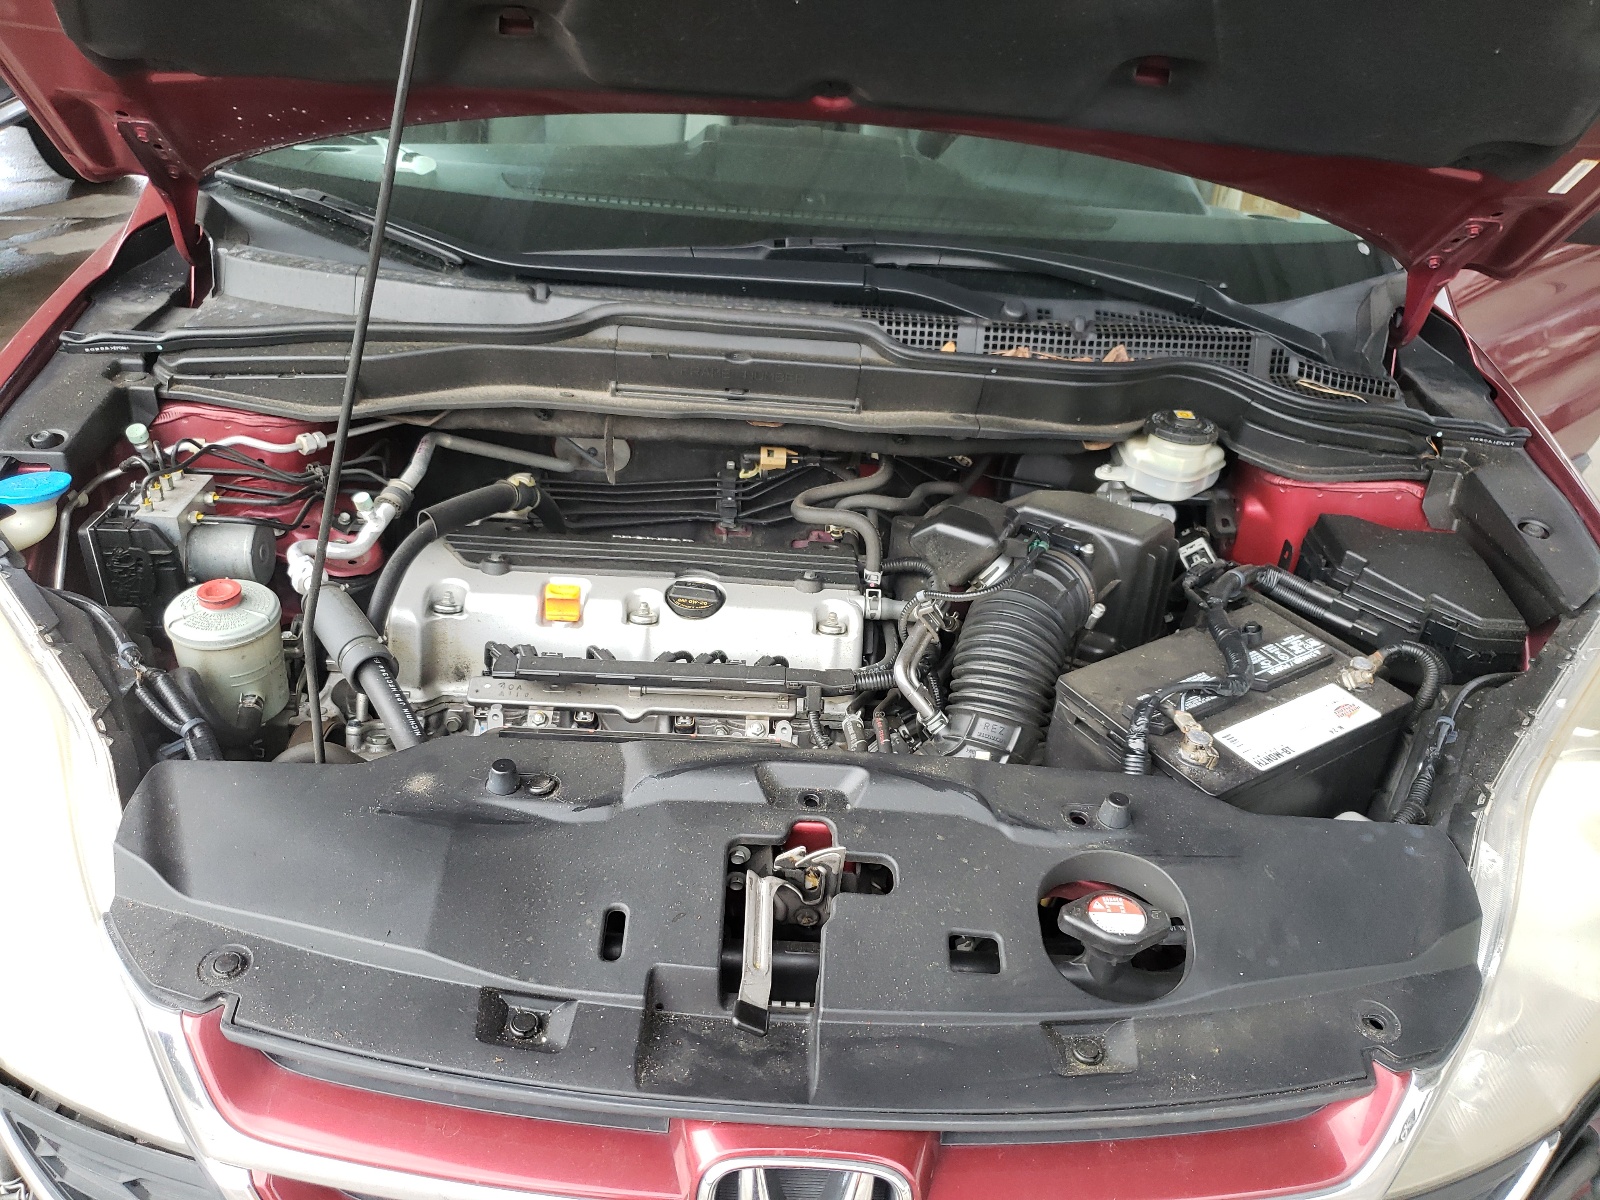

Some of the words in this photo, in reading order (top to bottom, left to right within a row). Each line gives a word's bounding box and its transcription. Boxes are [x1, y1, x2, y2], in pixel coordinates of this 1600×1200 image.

[402, 708, 422, 736] NICHIRIN
[983, 722, 1005, 736] REZ
[1254, 746, 1296, 768] 18-MONTH
